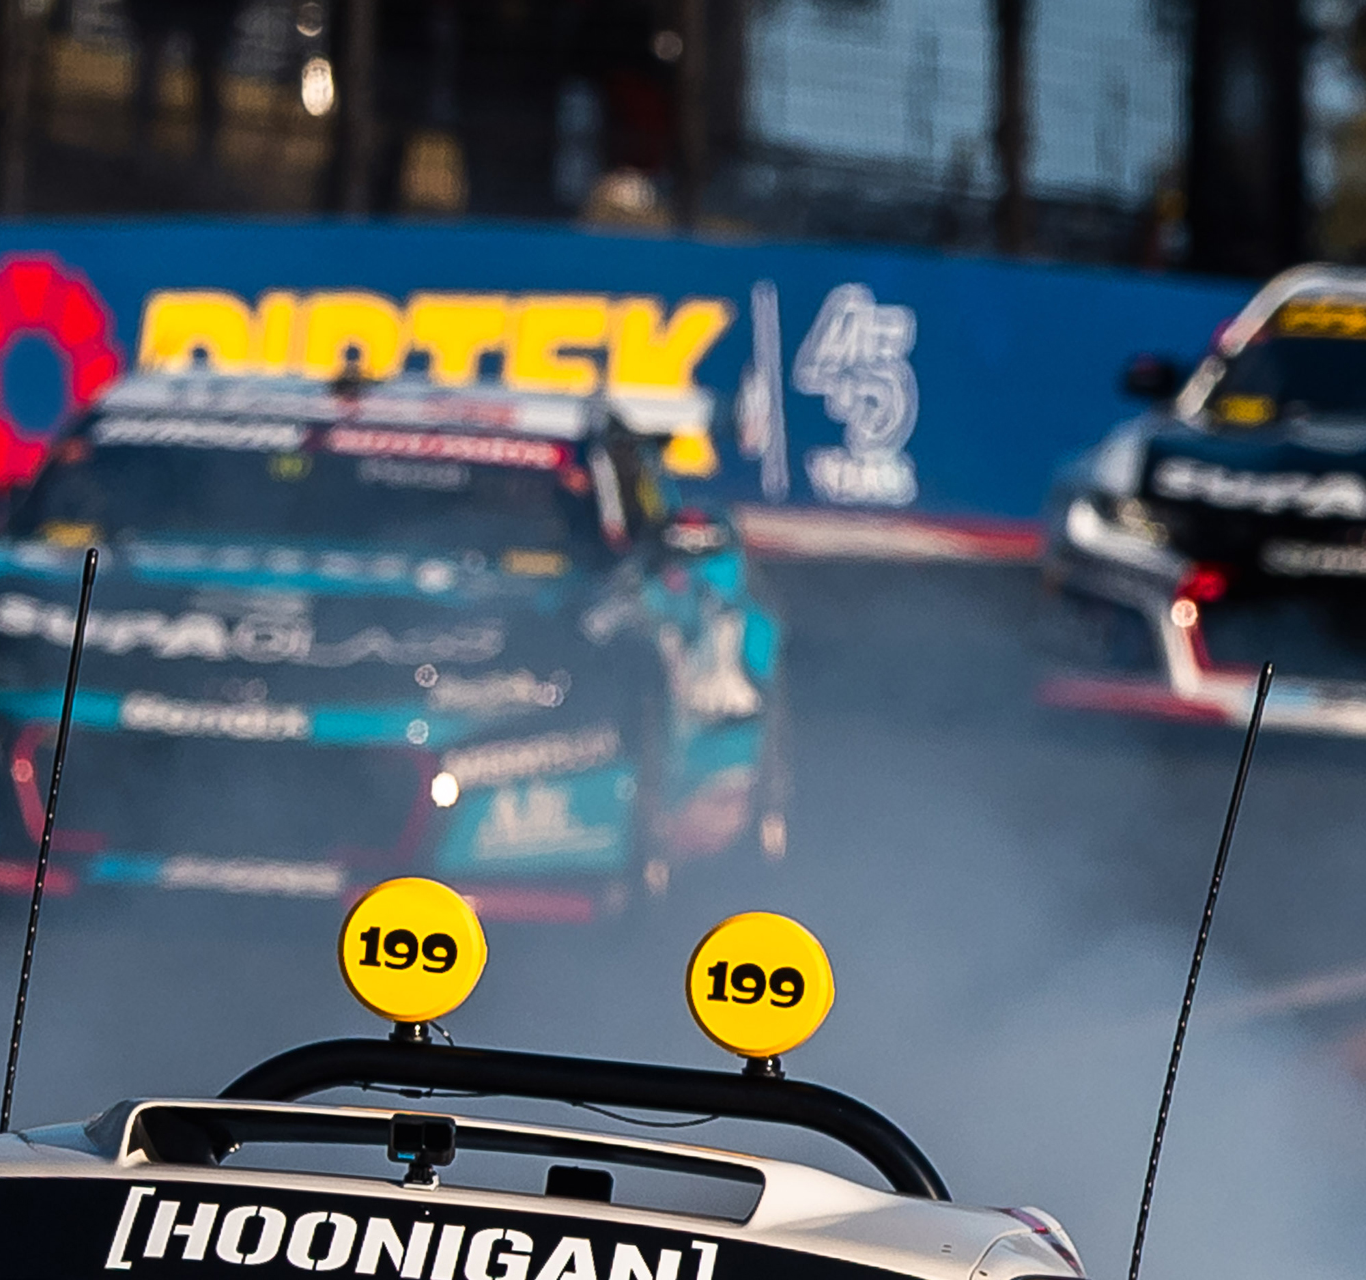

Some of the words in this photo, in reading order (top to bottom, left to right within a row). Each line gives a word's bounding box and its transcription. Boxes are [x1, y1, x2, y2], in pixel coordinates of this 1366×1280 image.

[792, 282, 919, 452] 45
[358, 926, 458, 974] 199
[707, 961, 805, 1008] 199
